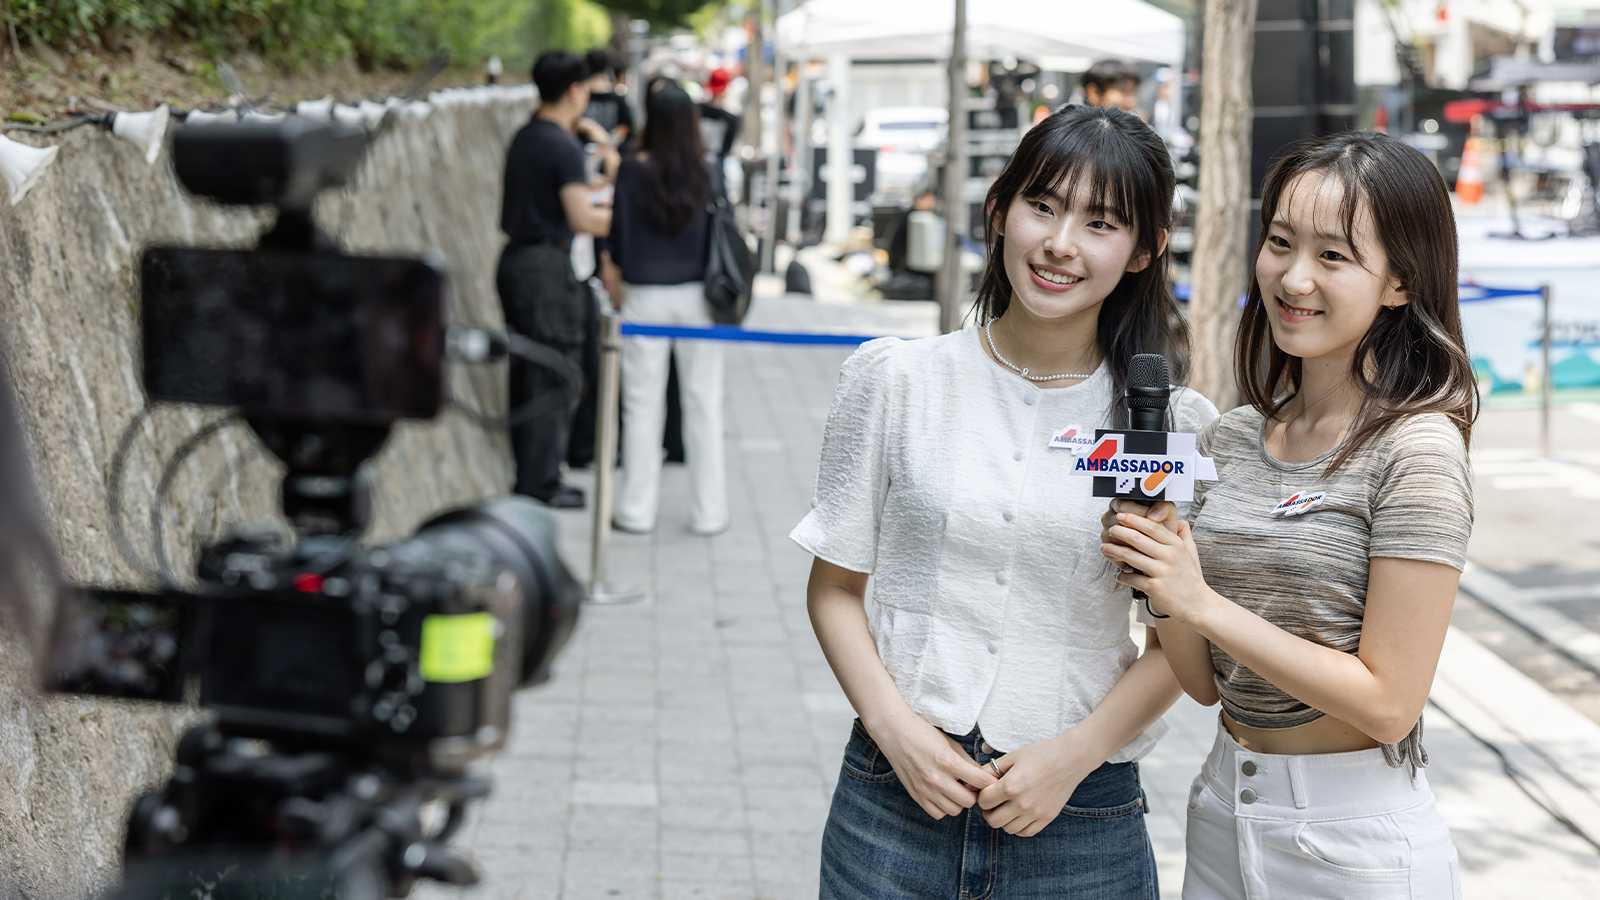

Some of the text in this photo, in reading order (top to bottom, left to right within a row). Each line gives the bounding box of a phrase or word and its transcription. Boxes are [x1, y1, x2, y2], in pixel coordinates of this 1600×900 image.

[1054, 436, 1095, 445] AMBASSA
[1075, 457, 1185, 474] AMBASSADOR
[1276, 494, 1323, 509] AMBASSADOR
